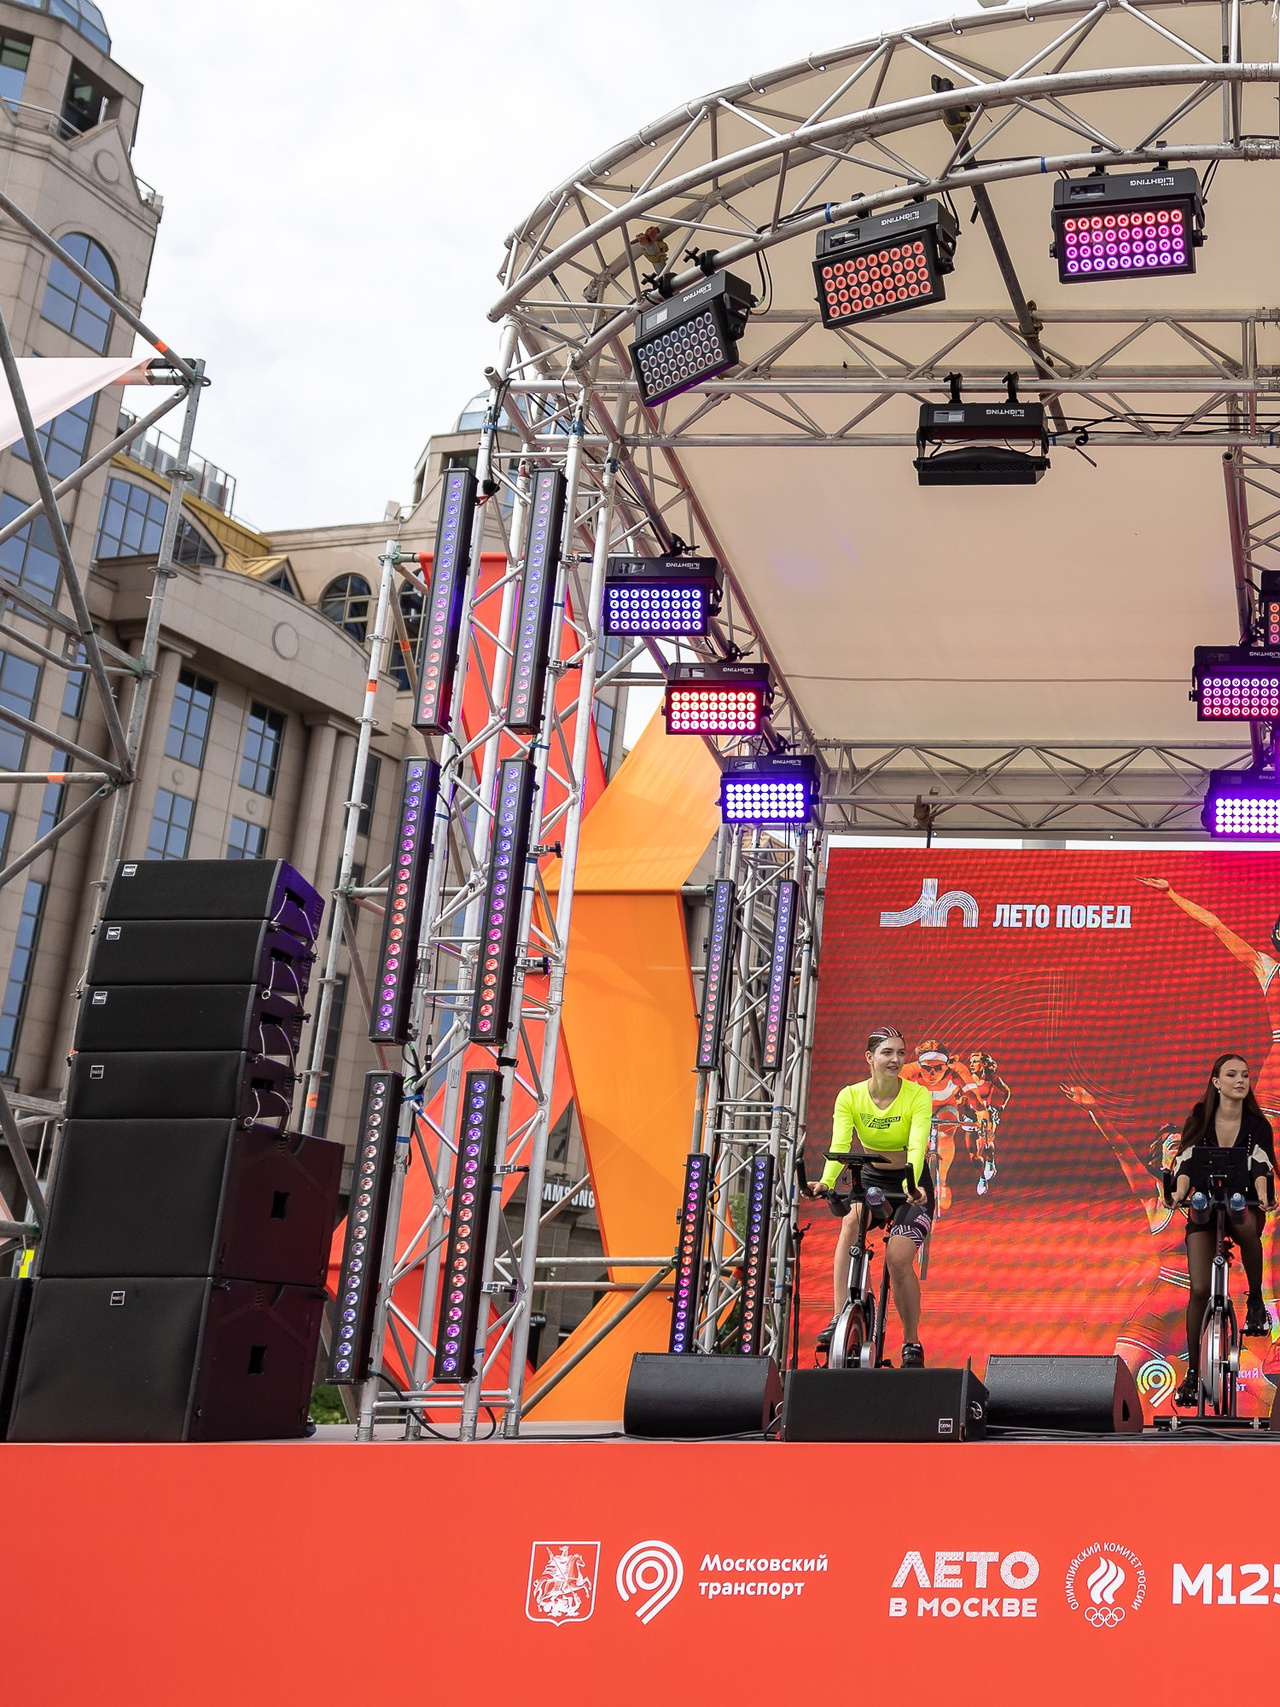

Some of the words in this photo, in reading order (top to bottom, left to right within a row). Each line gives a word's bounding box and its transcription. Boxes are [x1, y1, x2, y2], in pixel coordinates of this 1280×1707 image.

[992, 903, 1050, 928] ЛЕТО
[1056, 905, 1132, 928] ПОБЕД
[542, 1183, 596, 1209] AMNG
[699, 1553, 829, 1572] Московский
[891, 1550, 1040, 1589] ЛЕТО
[1065, 1542, 1101, 1610] ОЛИМПИЙСКИЙ
[1103, 1542, 1142, 1569] КОМИТЕТ
[1130, 1569, 1147, 1611] РОССИИ
[698, 1581, 806, 1600] транспорт
[888, 1597, 908, 1617] В
[917, 1597, 1038, 1617] МОСКВЕ
